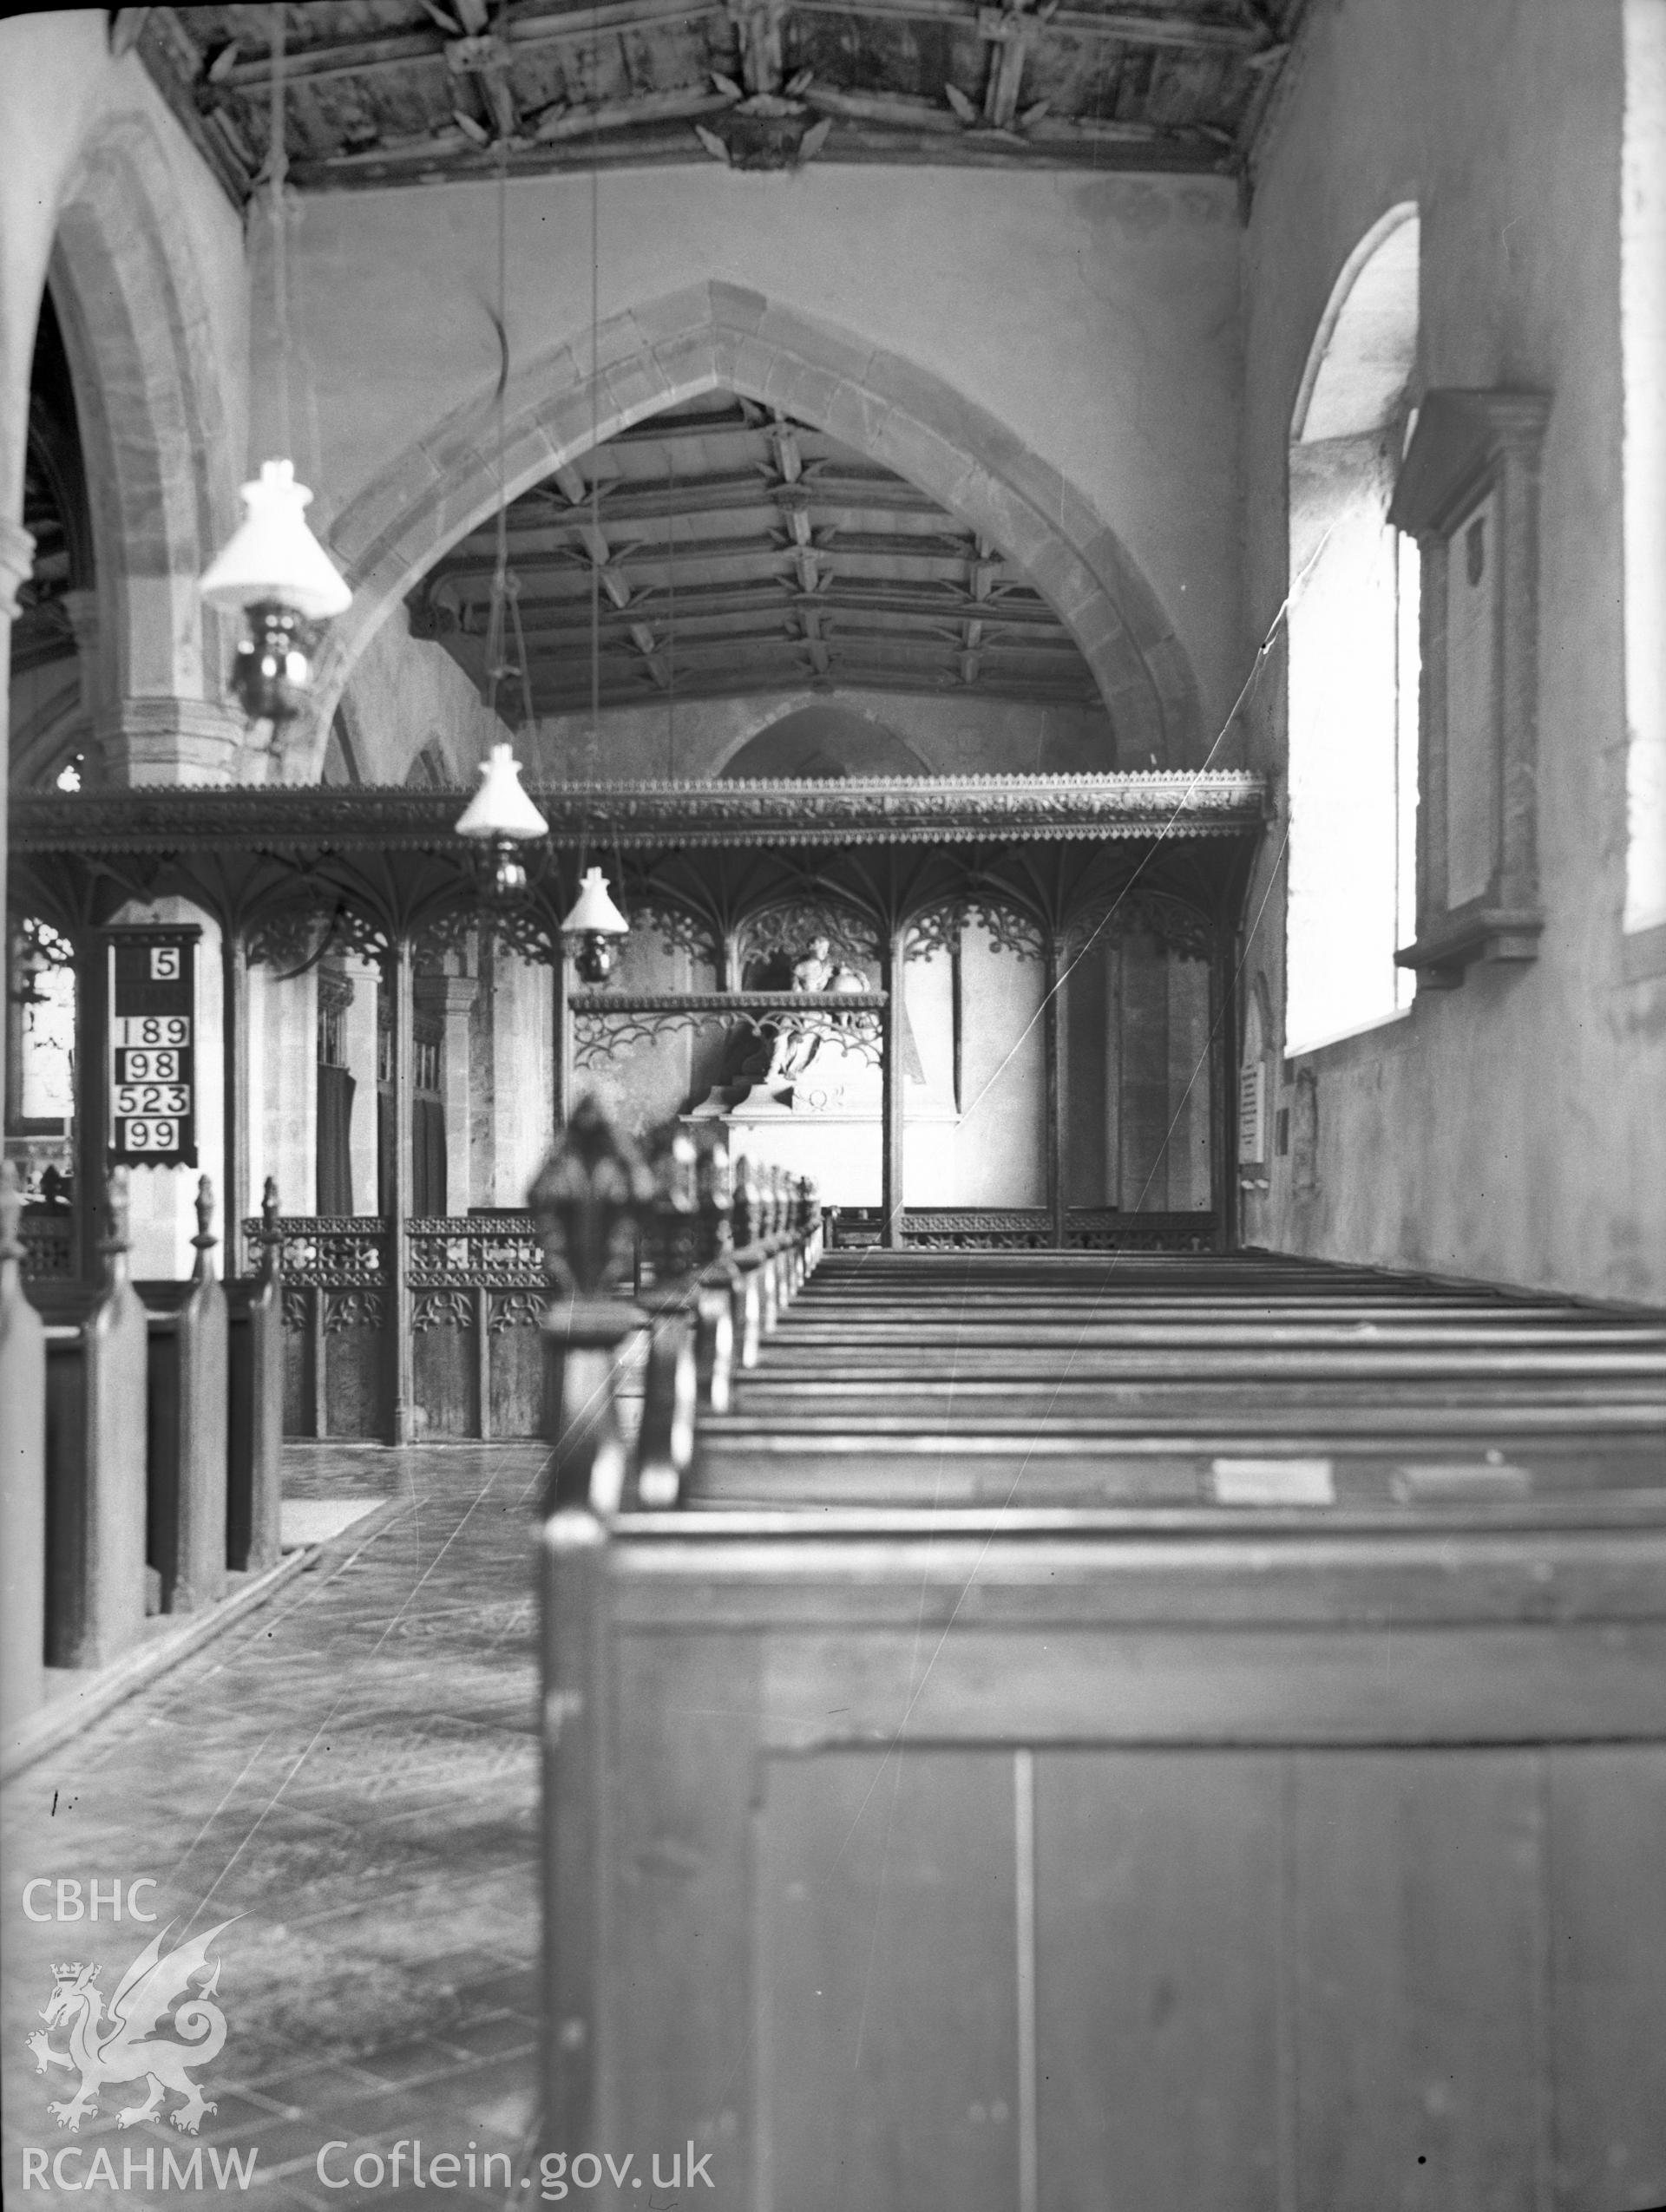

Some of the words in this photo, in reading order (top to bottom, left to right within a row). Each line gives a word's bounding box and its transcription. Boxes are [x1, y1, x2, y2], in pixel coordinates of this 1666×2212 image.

[155, 951, 175, 977] 5
[123, 1018, 187, 1044] 189
[129, 1053, 175, 1079] 98
[118, 1087, 187, 1114] 523
[129, 1122, 175, 1148] 99
